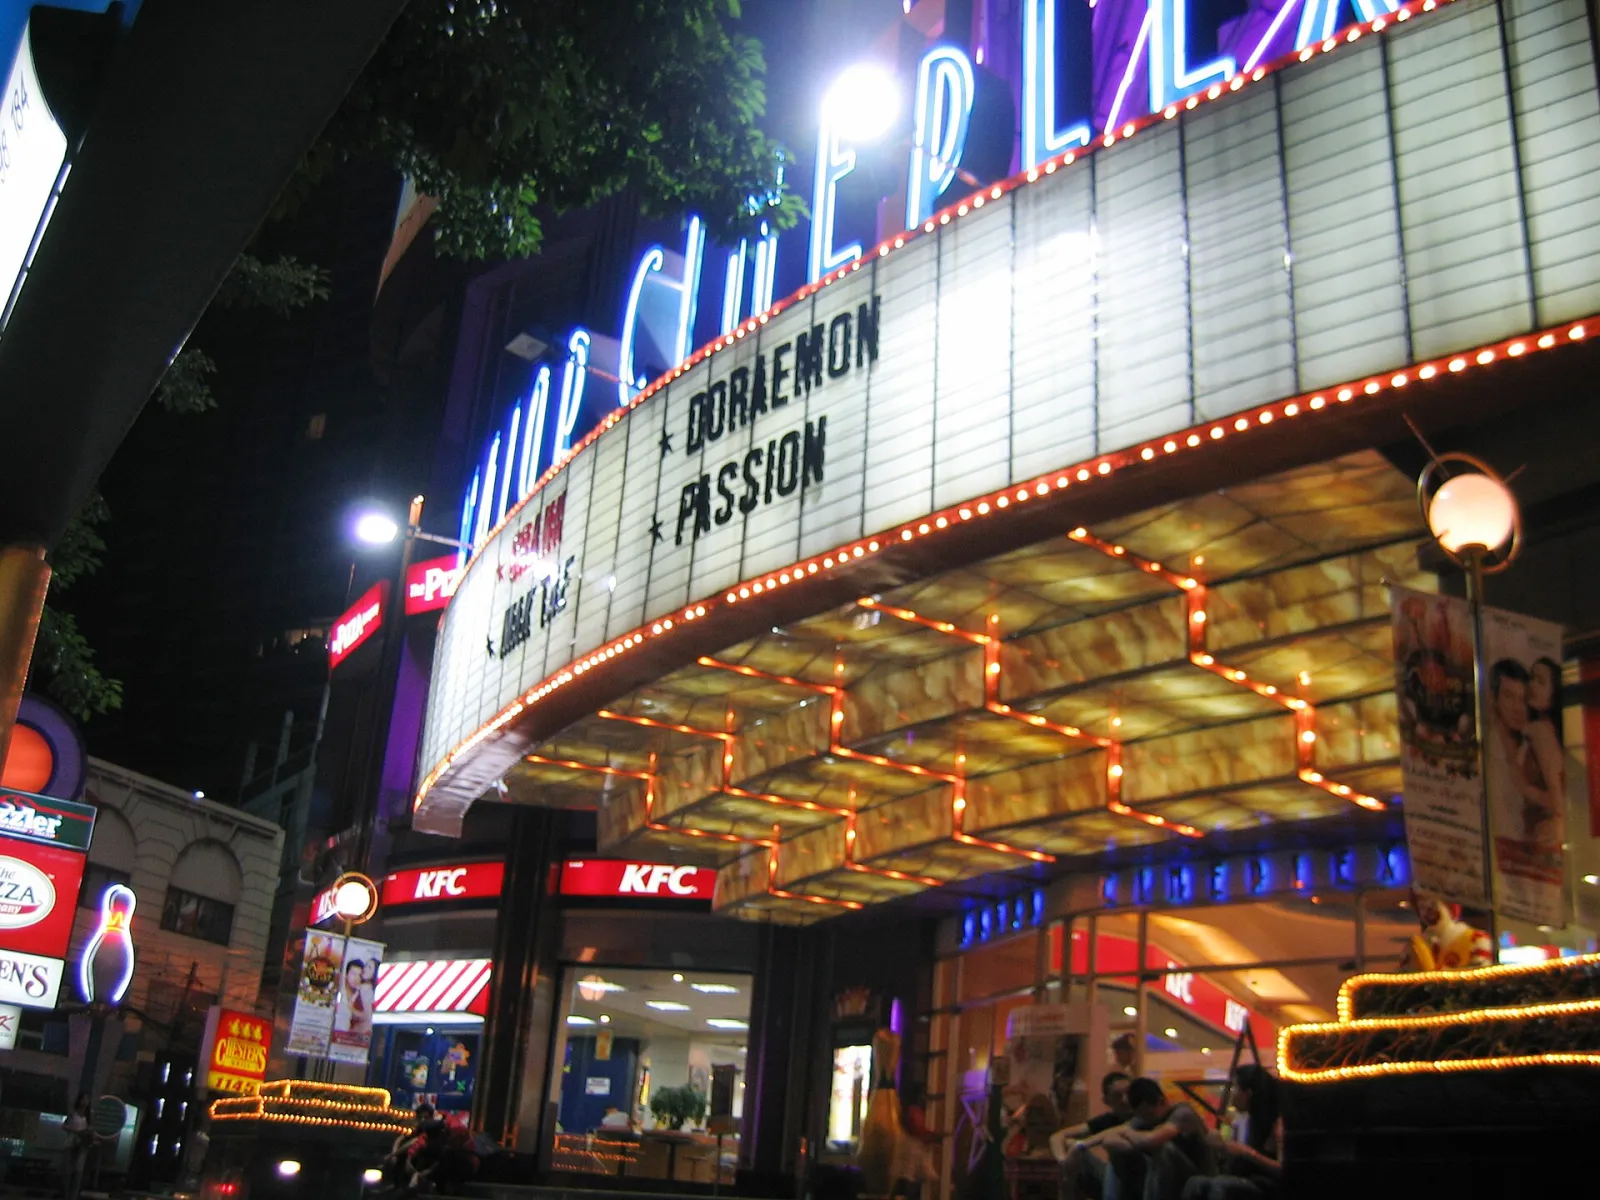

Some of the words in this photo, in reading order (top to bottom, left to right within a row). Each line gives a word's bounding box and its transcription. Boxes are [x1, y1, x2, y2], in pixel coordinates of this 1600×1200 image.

[686, 295, 881, 456] DORAEMON
[675, 415, 827, 546] PASSION
[0, 867, 16, 880] he
[414, 867, 467, 899] KFC
[618, 864, 698, 895] KFC
[0, 903, 22, 914] any
[215, 1076, 256, 1095] 1145
